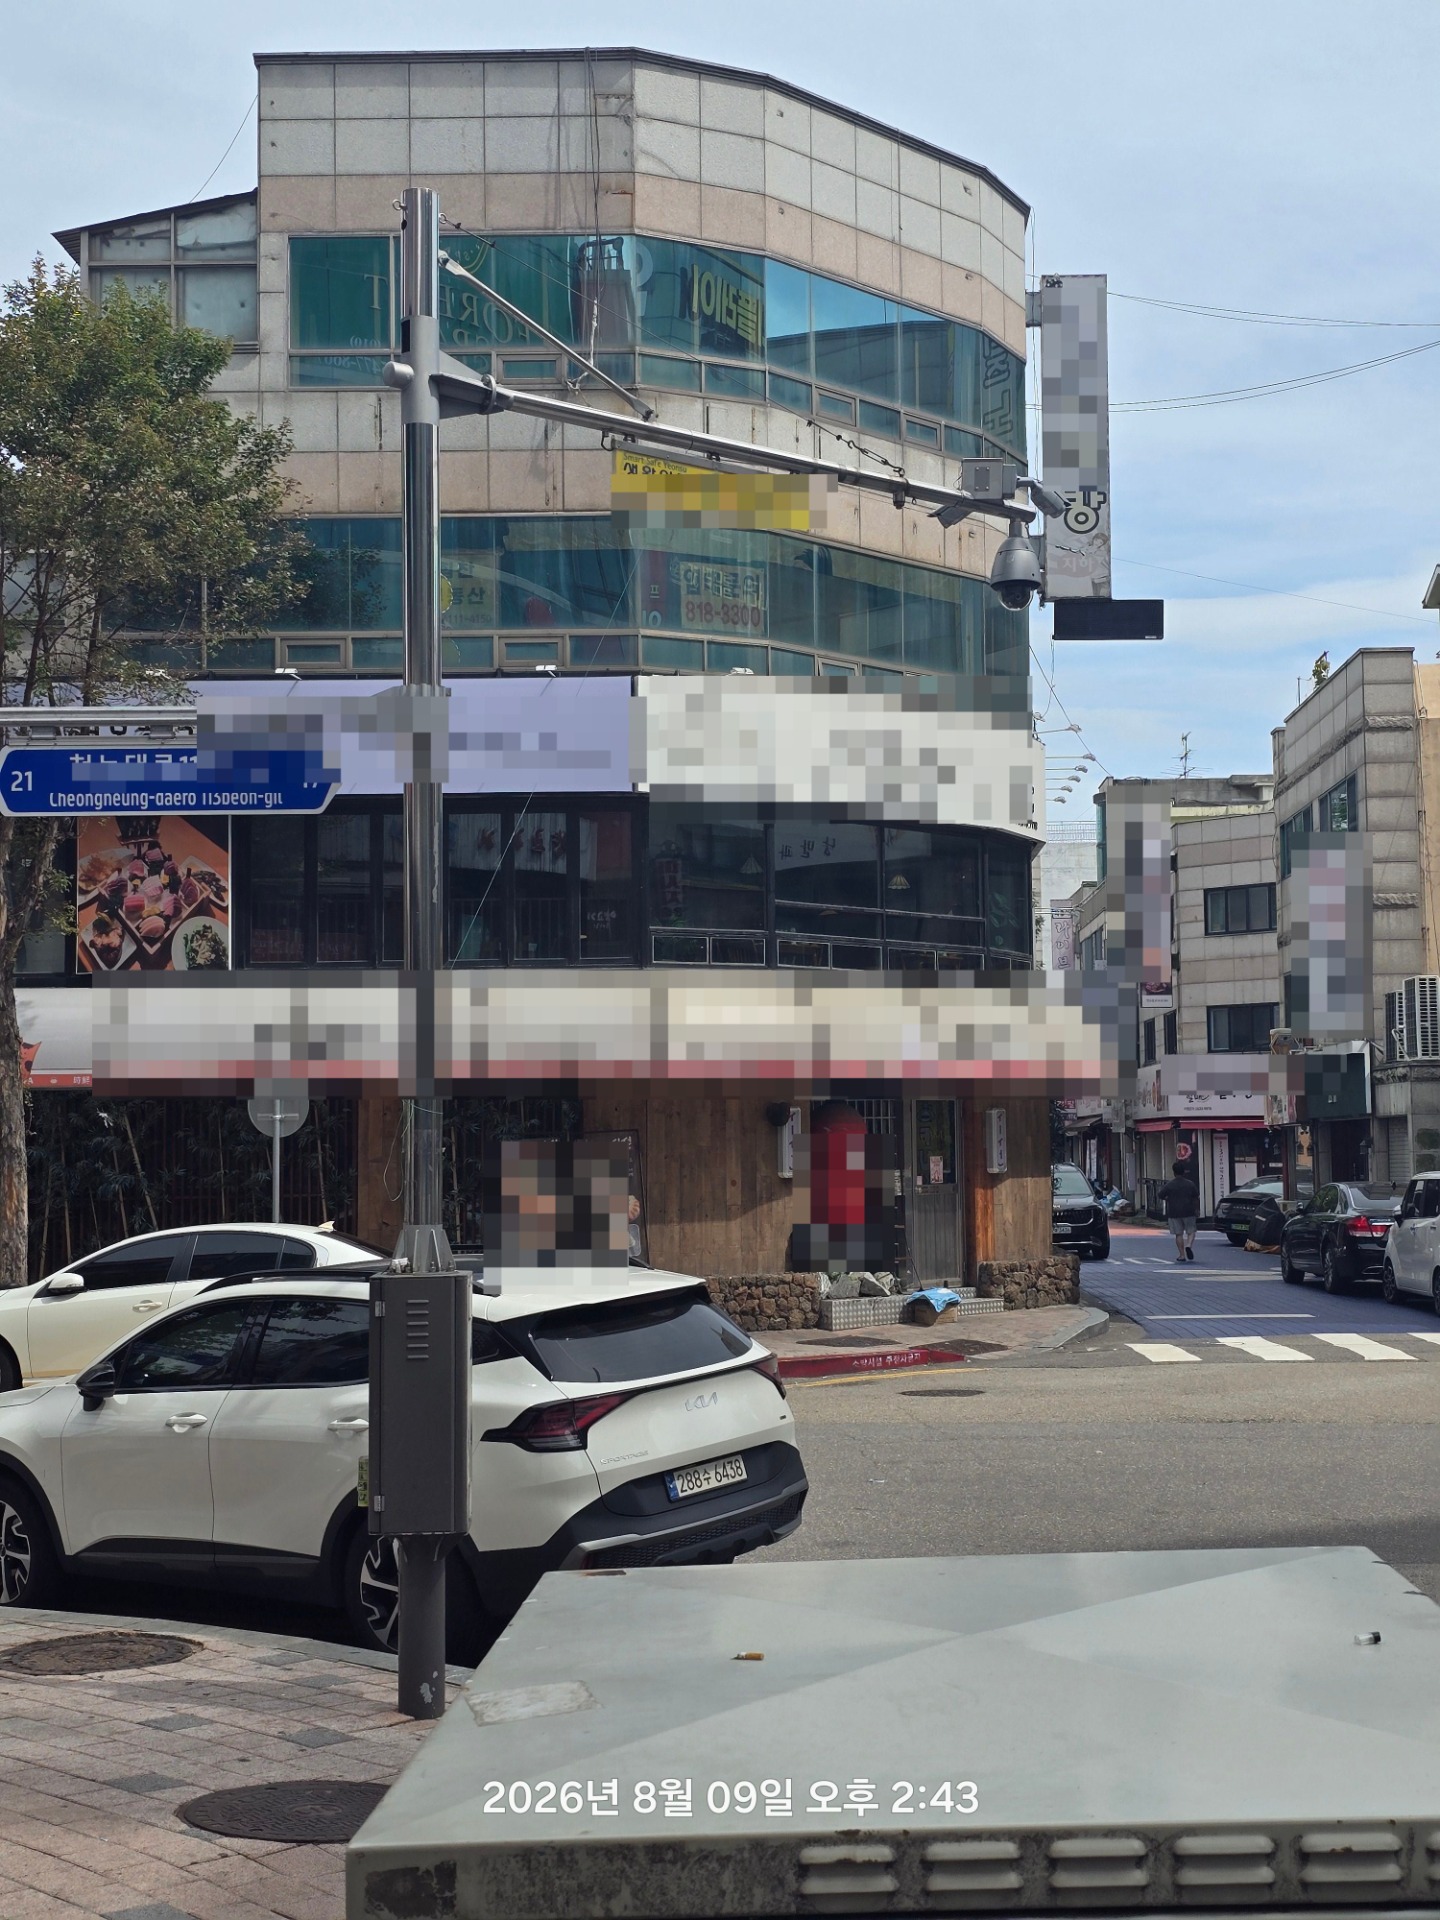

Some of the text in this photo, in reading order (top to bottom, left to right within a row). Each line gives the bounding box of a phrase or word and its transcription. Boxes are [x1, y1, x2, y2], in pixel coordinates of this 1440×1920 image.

[622, 452, 648, 463] Smart
[649, 456, 662, 467] Safe
[663, 460, 687, 473] Yeonsu
[11, 771, 33, 791] 21
[677, 1459, 743, 1494] 288수 6438
